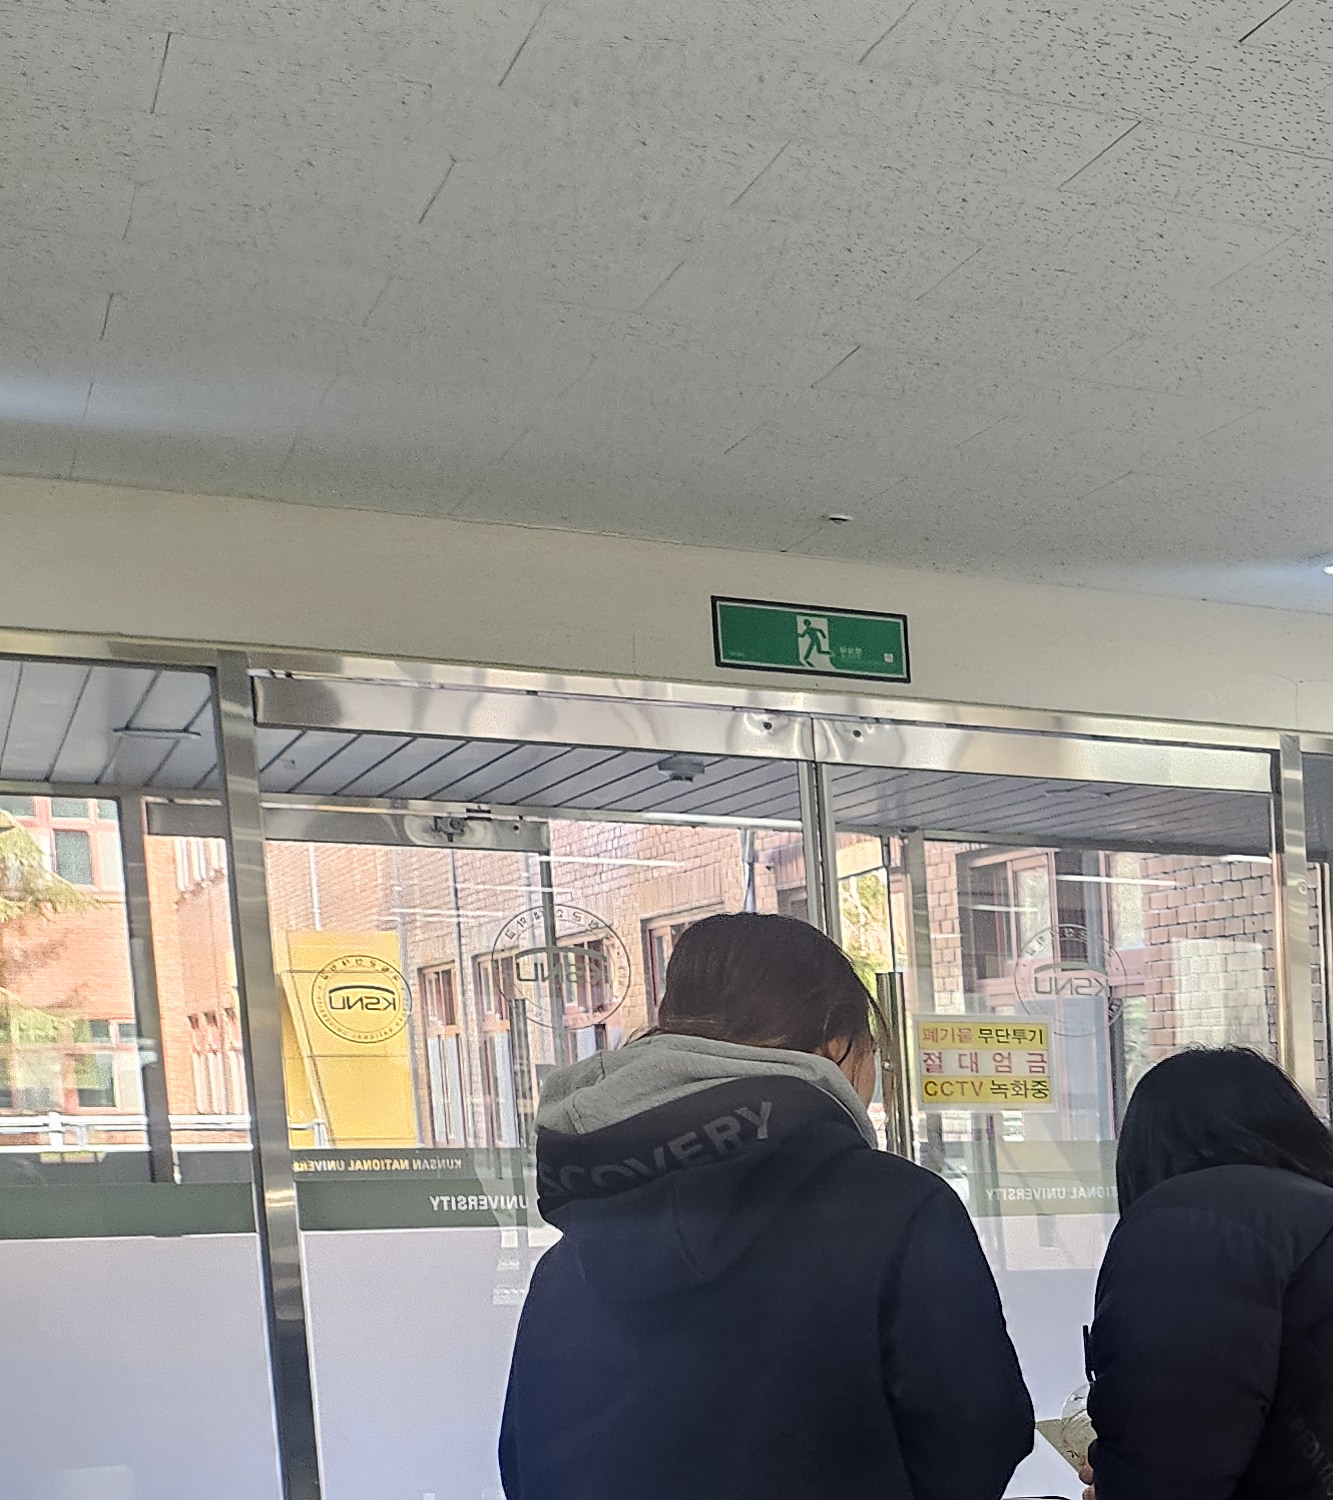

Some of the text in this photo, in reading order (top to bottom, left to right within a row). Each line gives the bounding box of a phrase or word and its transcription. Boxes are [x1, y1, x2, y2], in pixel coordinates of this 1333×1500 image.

[922, 1027, 1044, 1045] 폐기물 무단투기
[924, 1079, 1050, 1100] CCTV 녹화중
